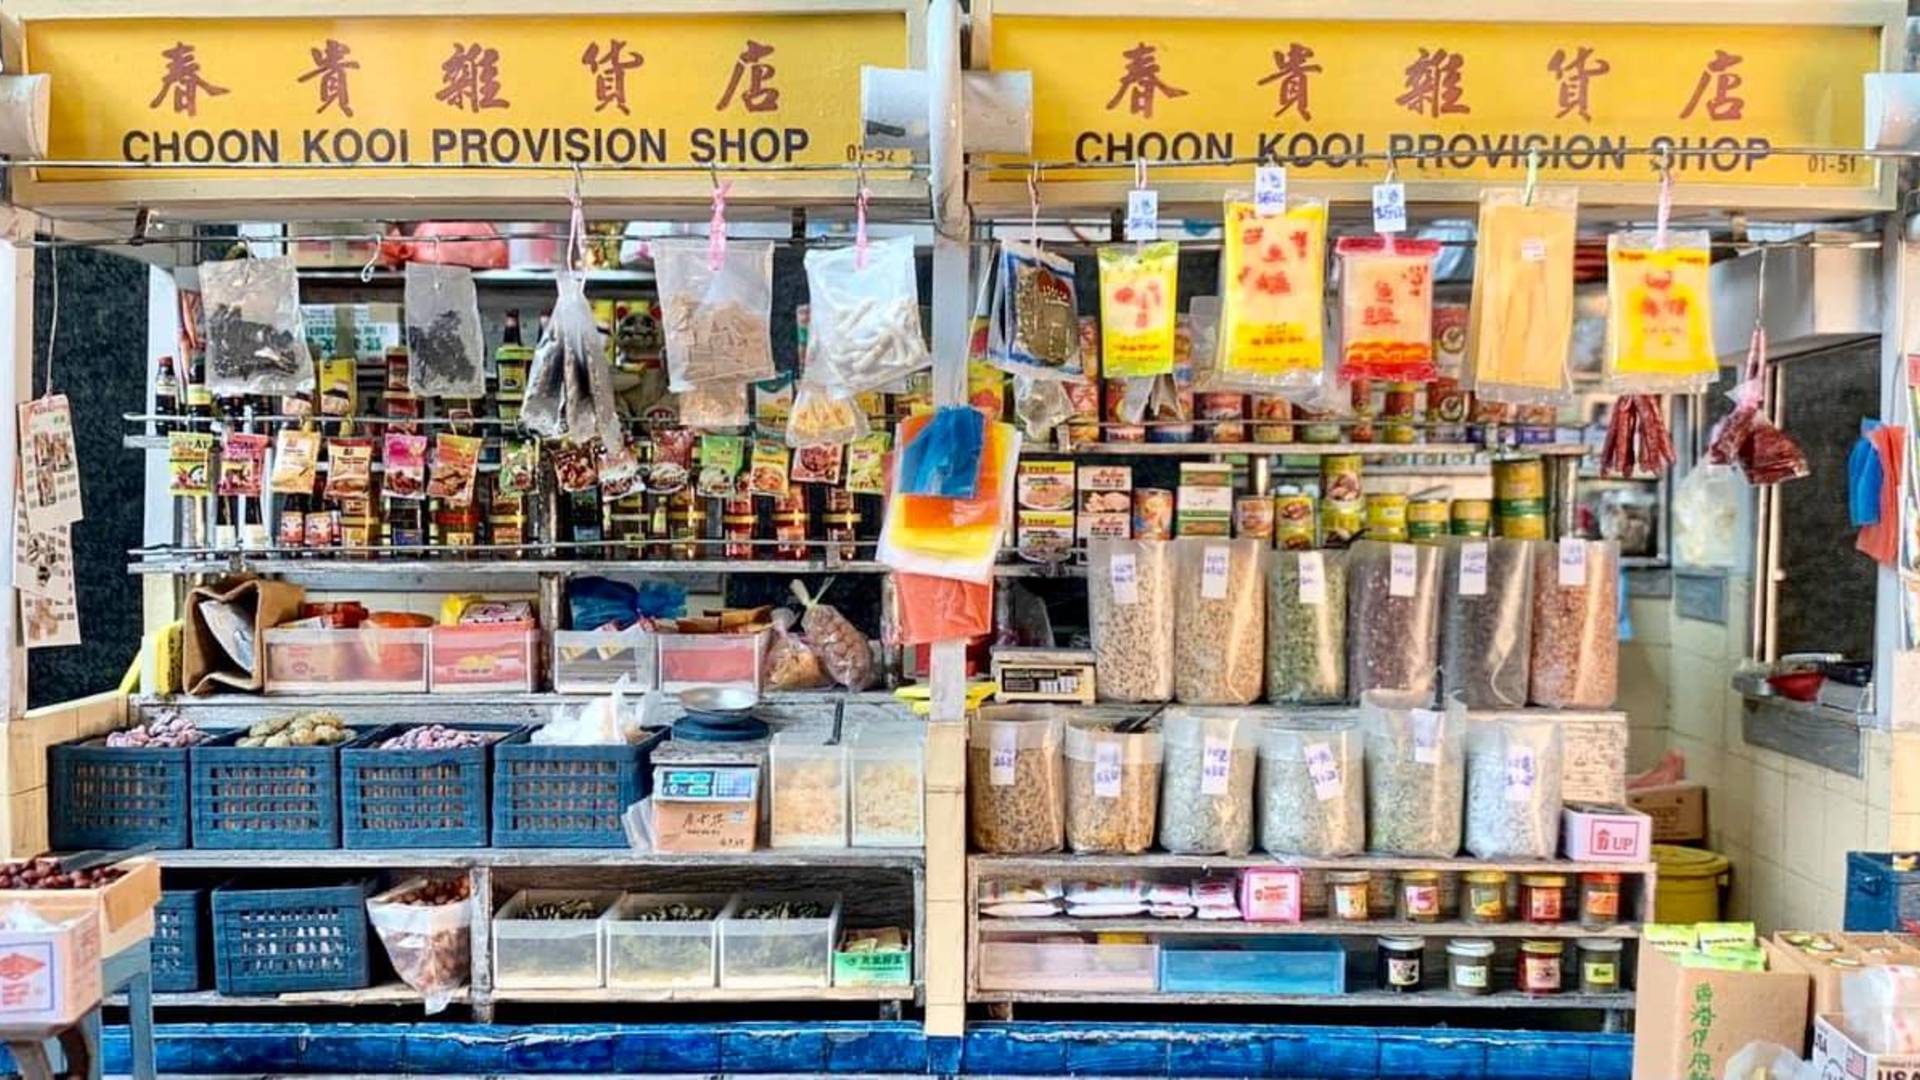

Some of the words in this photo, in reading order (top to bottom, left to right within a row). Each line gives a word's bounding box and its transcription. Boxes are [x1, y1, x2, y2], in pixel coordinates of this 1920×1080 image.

[149, 39, 781, 117] 春貴雜貨店
[1106, 41, 1745, 122] 春貴雜貨店
[122, 128, 279, 163] CHOON
[303, 128, 408, 163] KOOI
[432, 127, 667, 163] PROVISION
[690, 127, 810, 163] SHOP
[1075, 131, 1234, 167] CHOON
[1258, 132, 1366, 168] KOOI
[1390, 133, 1626, 170] PROVISION
[1650, 135, 1770, 172] SHOP
[1807, 154, 1857, 174] 01-51
[1613, 836, 1634, 851] UP
